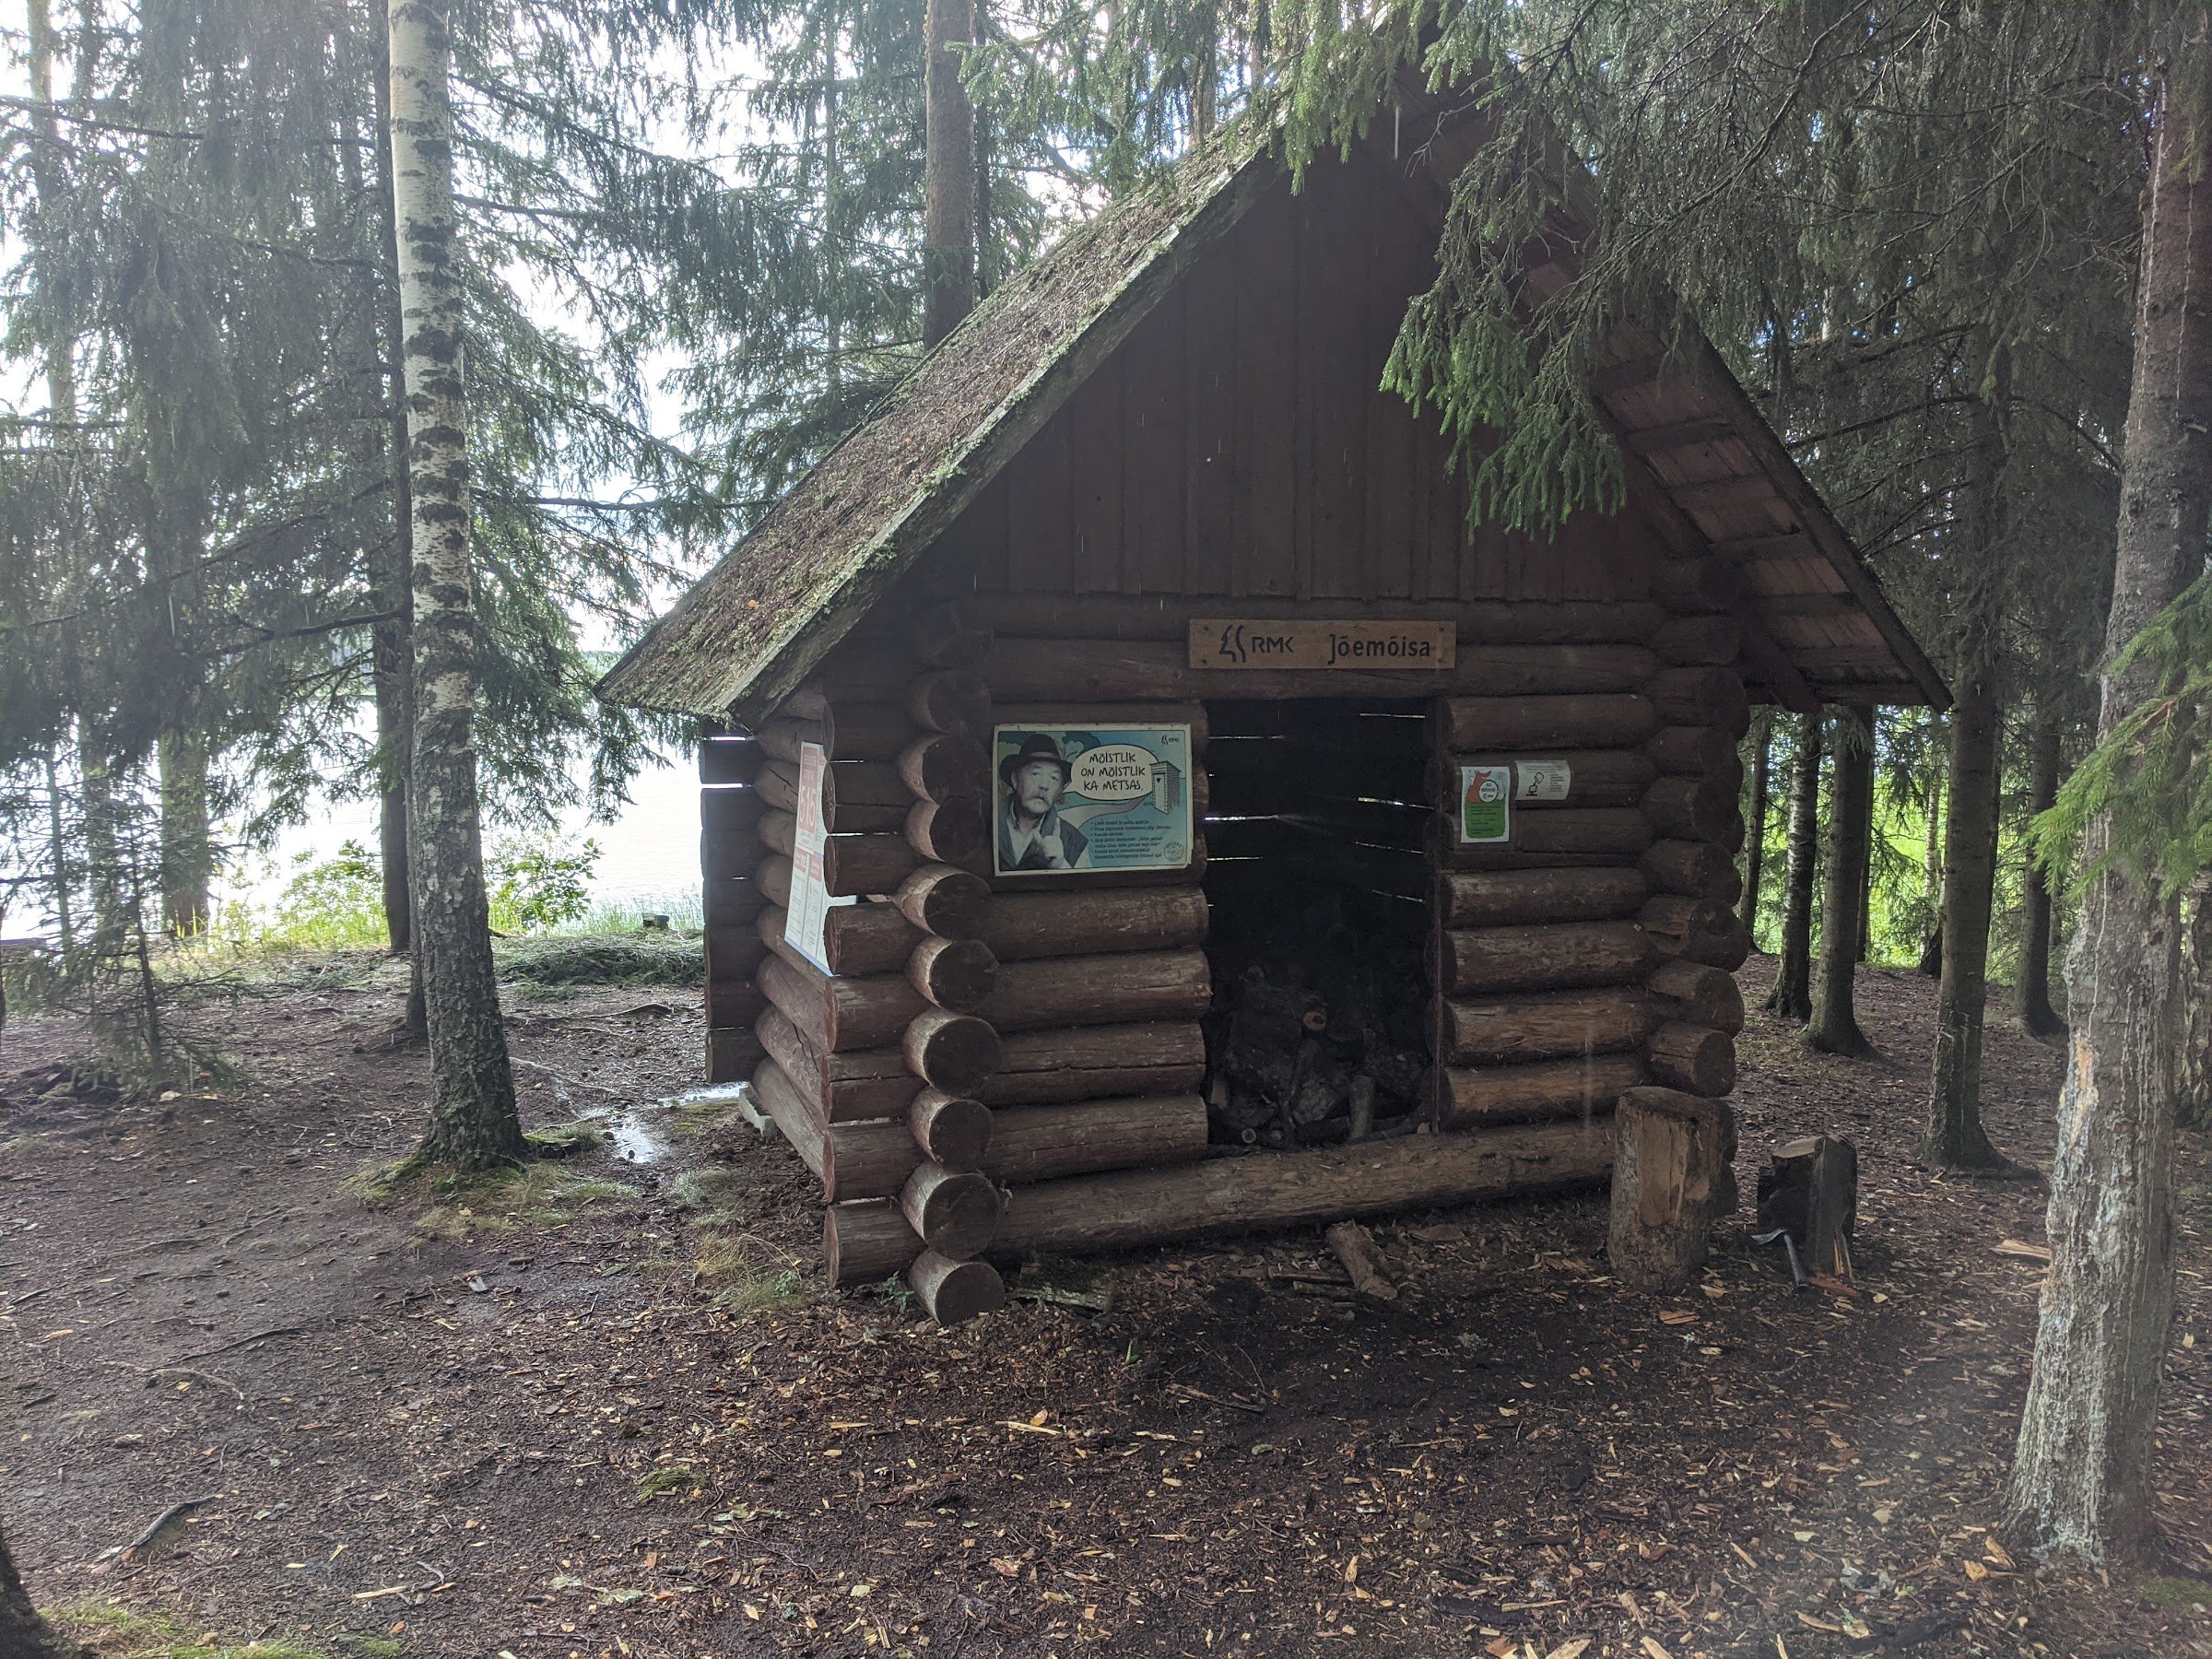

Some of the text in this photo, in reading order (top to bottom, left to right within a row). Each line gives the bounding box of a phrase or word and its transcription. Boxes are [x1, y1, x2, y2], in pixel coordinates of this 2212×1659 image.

[1252, 636, 1295, 653] RMK
[1089, 752, 1135, 763] MÕISTLIK
[1080, 766, 1146, 777] ON MÕISTLIK
[1084, 780, 1143, 791] KA METSAS.
